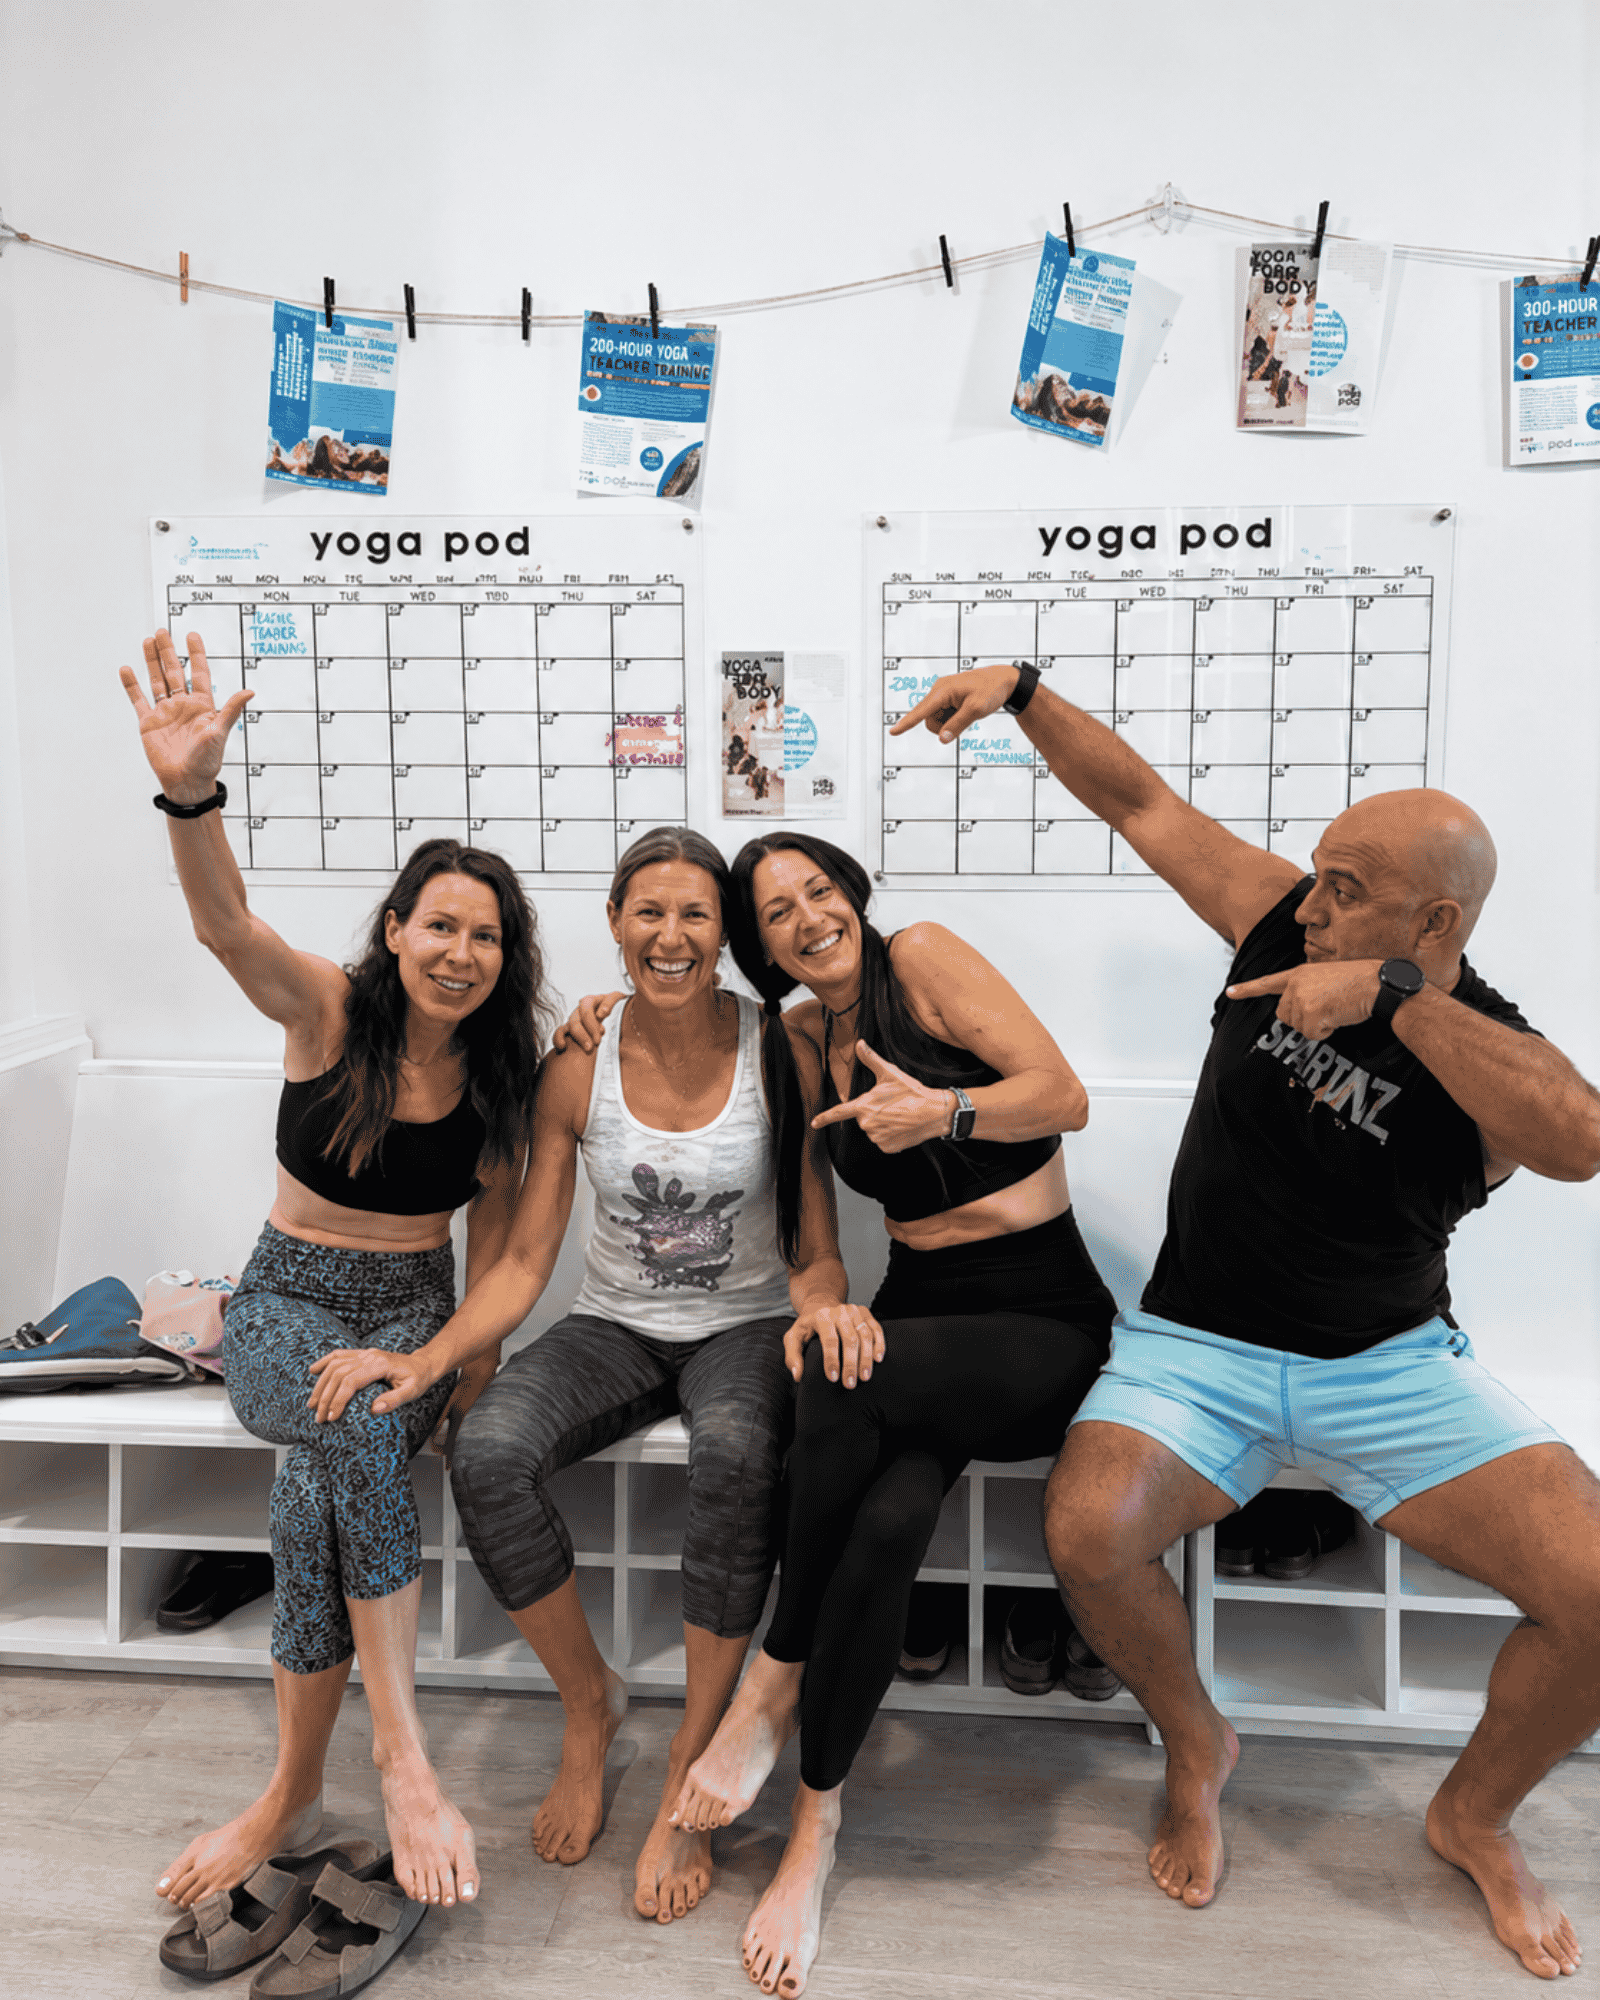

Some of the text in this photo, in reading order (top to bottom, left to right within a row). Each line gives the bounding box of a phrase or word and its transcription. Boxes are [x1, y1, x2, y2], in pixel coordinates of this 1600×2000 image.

[1264, 280, 1316, 294] BODY
[1523, 297, 1598, 317] 300-HOUR
[1523, 316, 1597, 333] TEACHER
[590, 338, 689, 360] 200-HOUR YOGA
[310, 531, 422, 565] yoga
[444, 526, 529, 562] pod
[1038, 517, 1272, 559] yoga pod
[191, 591, 213, 601] SUN
[263, 591, 290, 601] MON
[339, 591, 360, 601] TUE
[410, 591, 436, 602] WED
[561, 591, 584, 601] THU
[636, 591, 657, 601] SAT
[908, 589, 932, 599] SUN
[985, 588, 1012, 599] MON
[1065, 587, 1087, 598] TUE
[1139, 586, 1166, 597] WED
[1224, 585, 1249, 596] THU
[722, 659, 762, 675] YOGA
[735, 685, 781, 699] BODY
